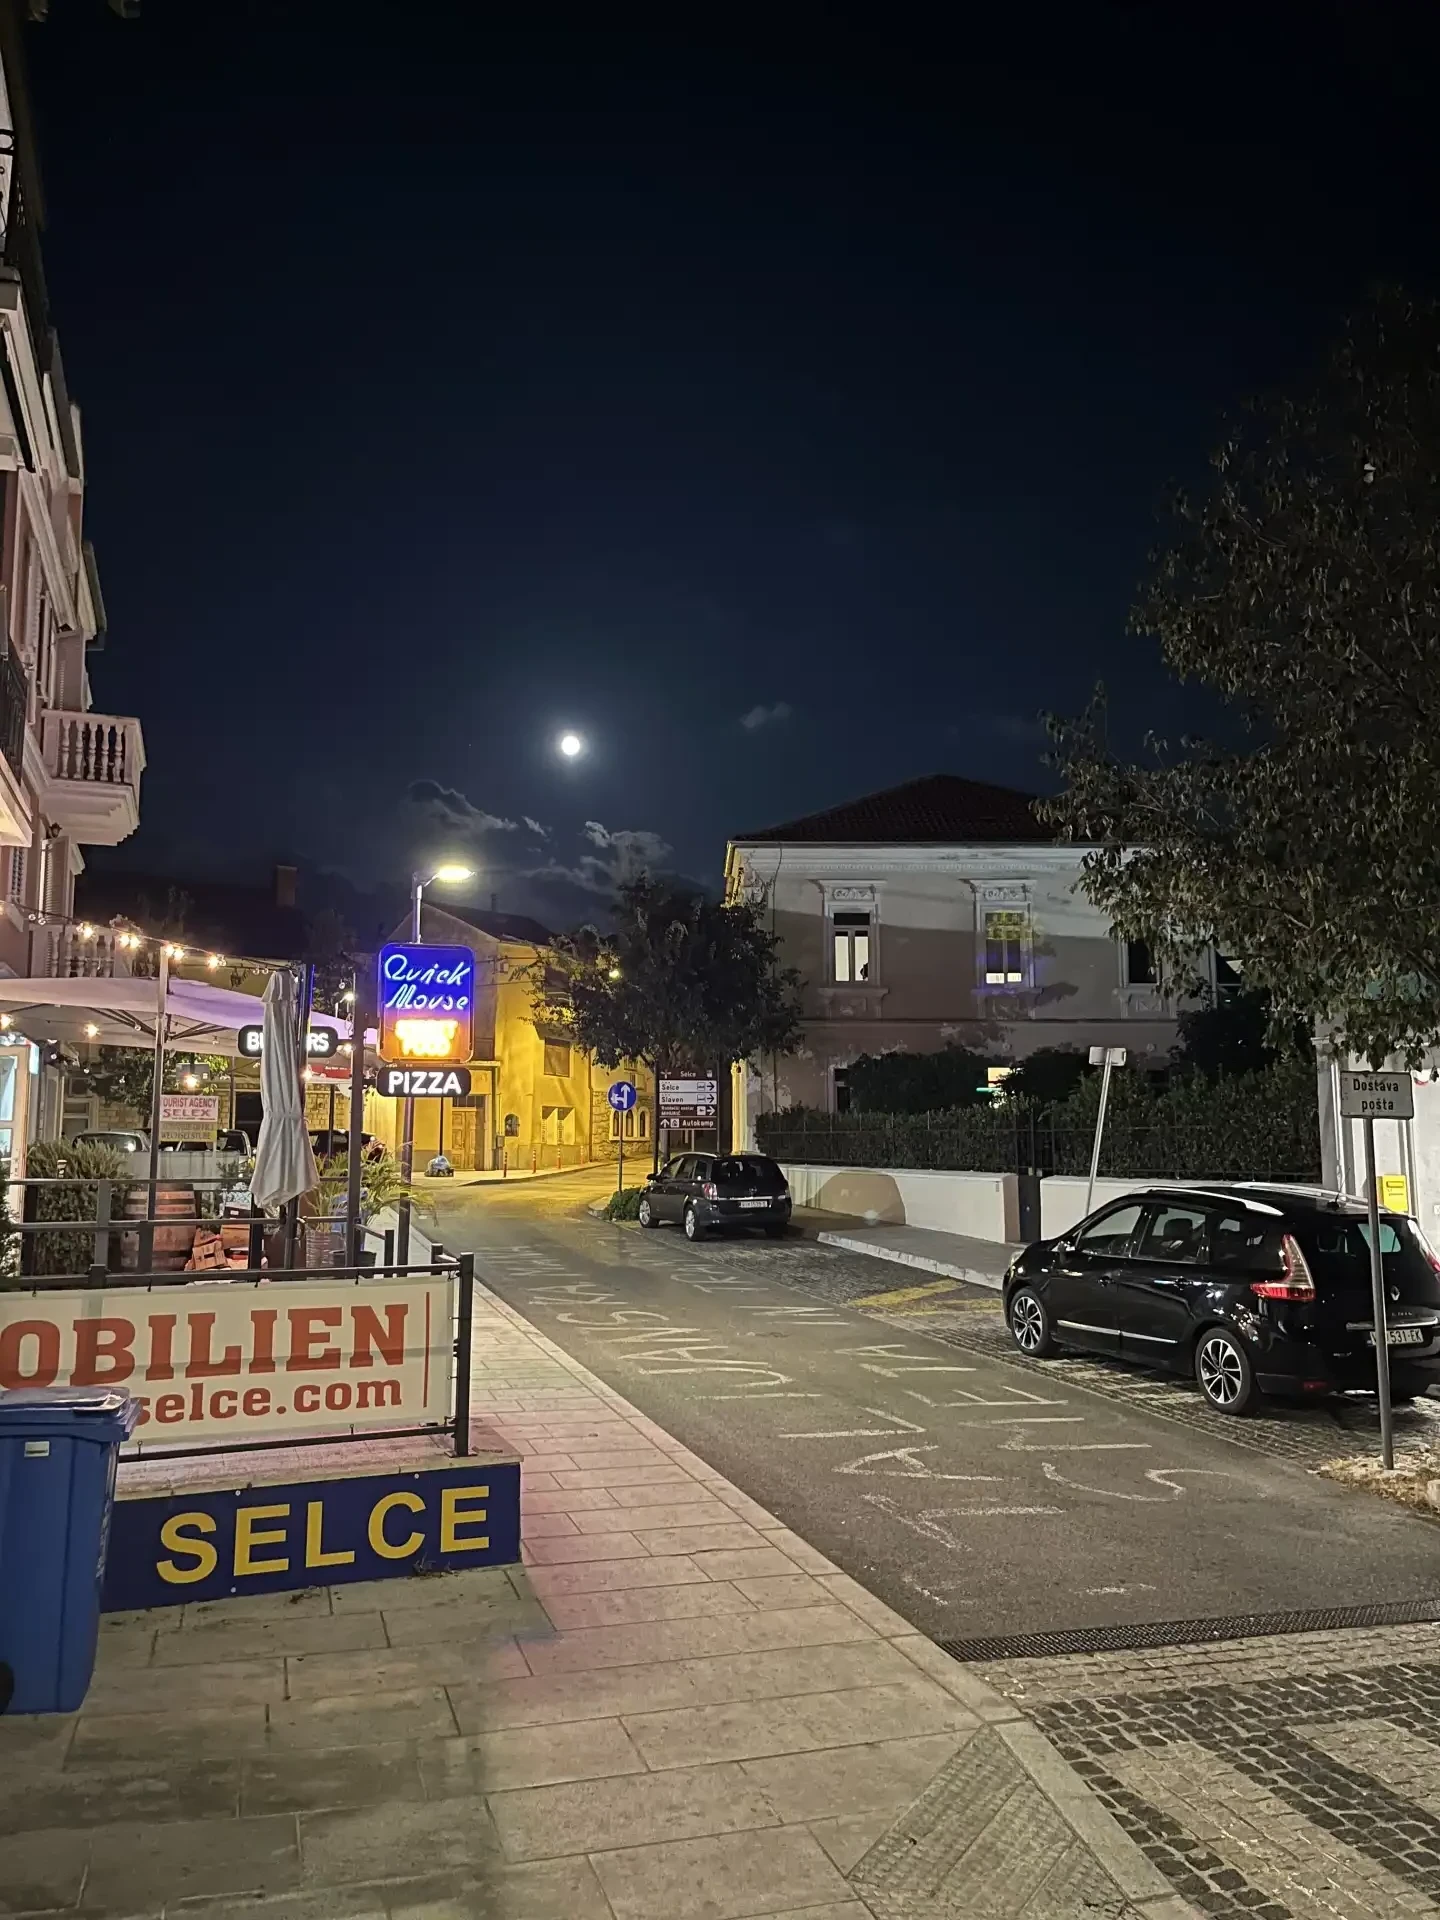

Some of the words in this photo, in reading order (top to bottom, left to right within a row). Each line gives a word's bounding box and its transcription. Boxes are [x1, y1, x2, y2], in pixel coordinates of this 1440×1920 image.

[384, 954, 471, 985] Quick
[385, 984, 469, 1011] Mouse
[680, 1071, 697, 1079] Selce
[388, 1070, 462, 1095] PIZZA
[661, 1083, 680, 1091] Selce
[1353, 1078, 1399, 1092] Dostava
[189, 1097, 217, 1108] AGENCY
[1362, 1098, 1394, 1112] pošta
[163, 1108, 211, 1118] SELEX
[0, 1303, 408, 1389] OBILIEN
[156, 1485, 490, 1584] SELCE
